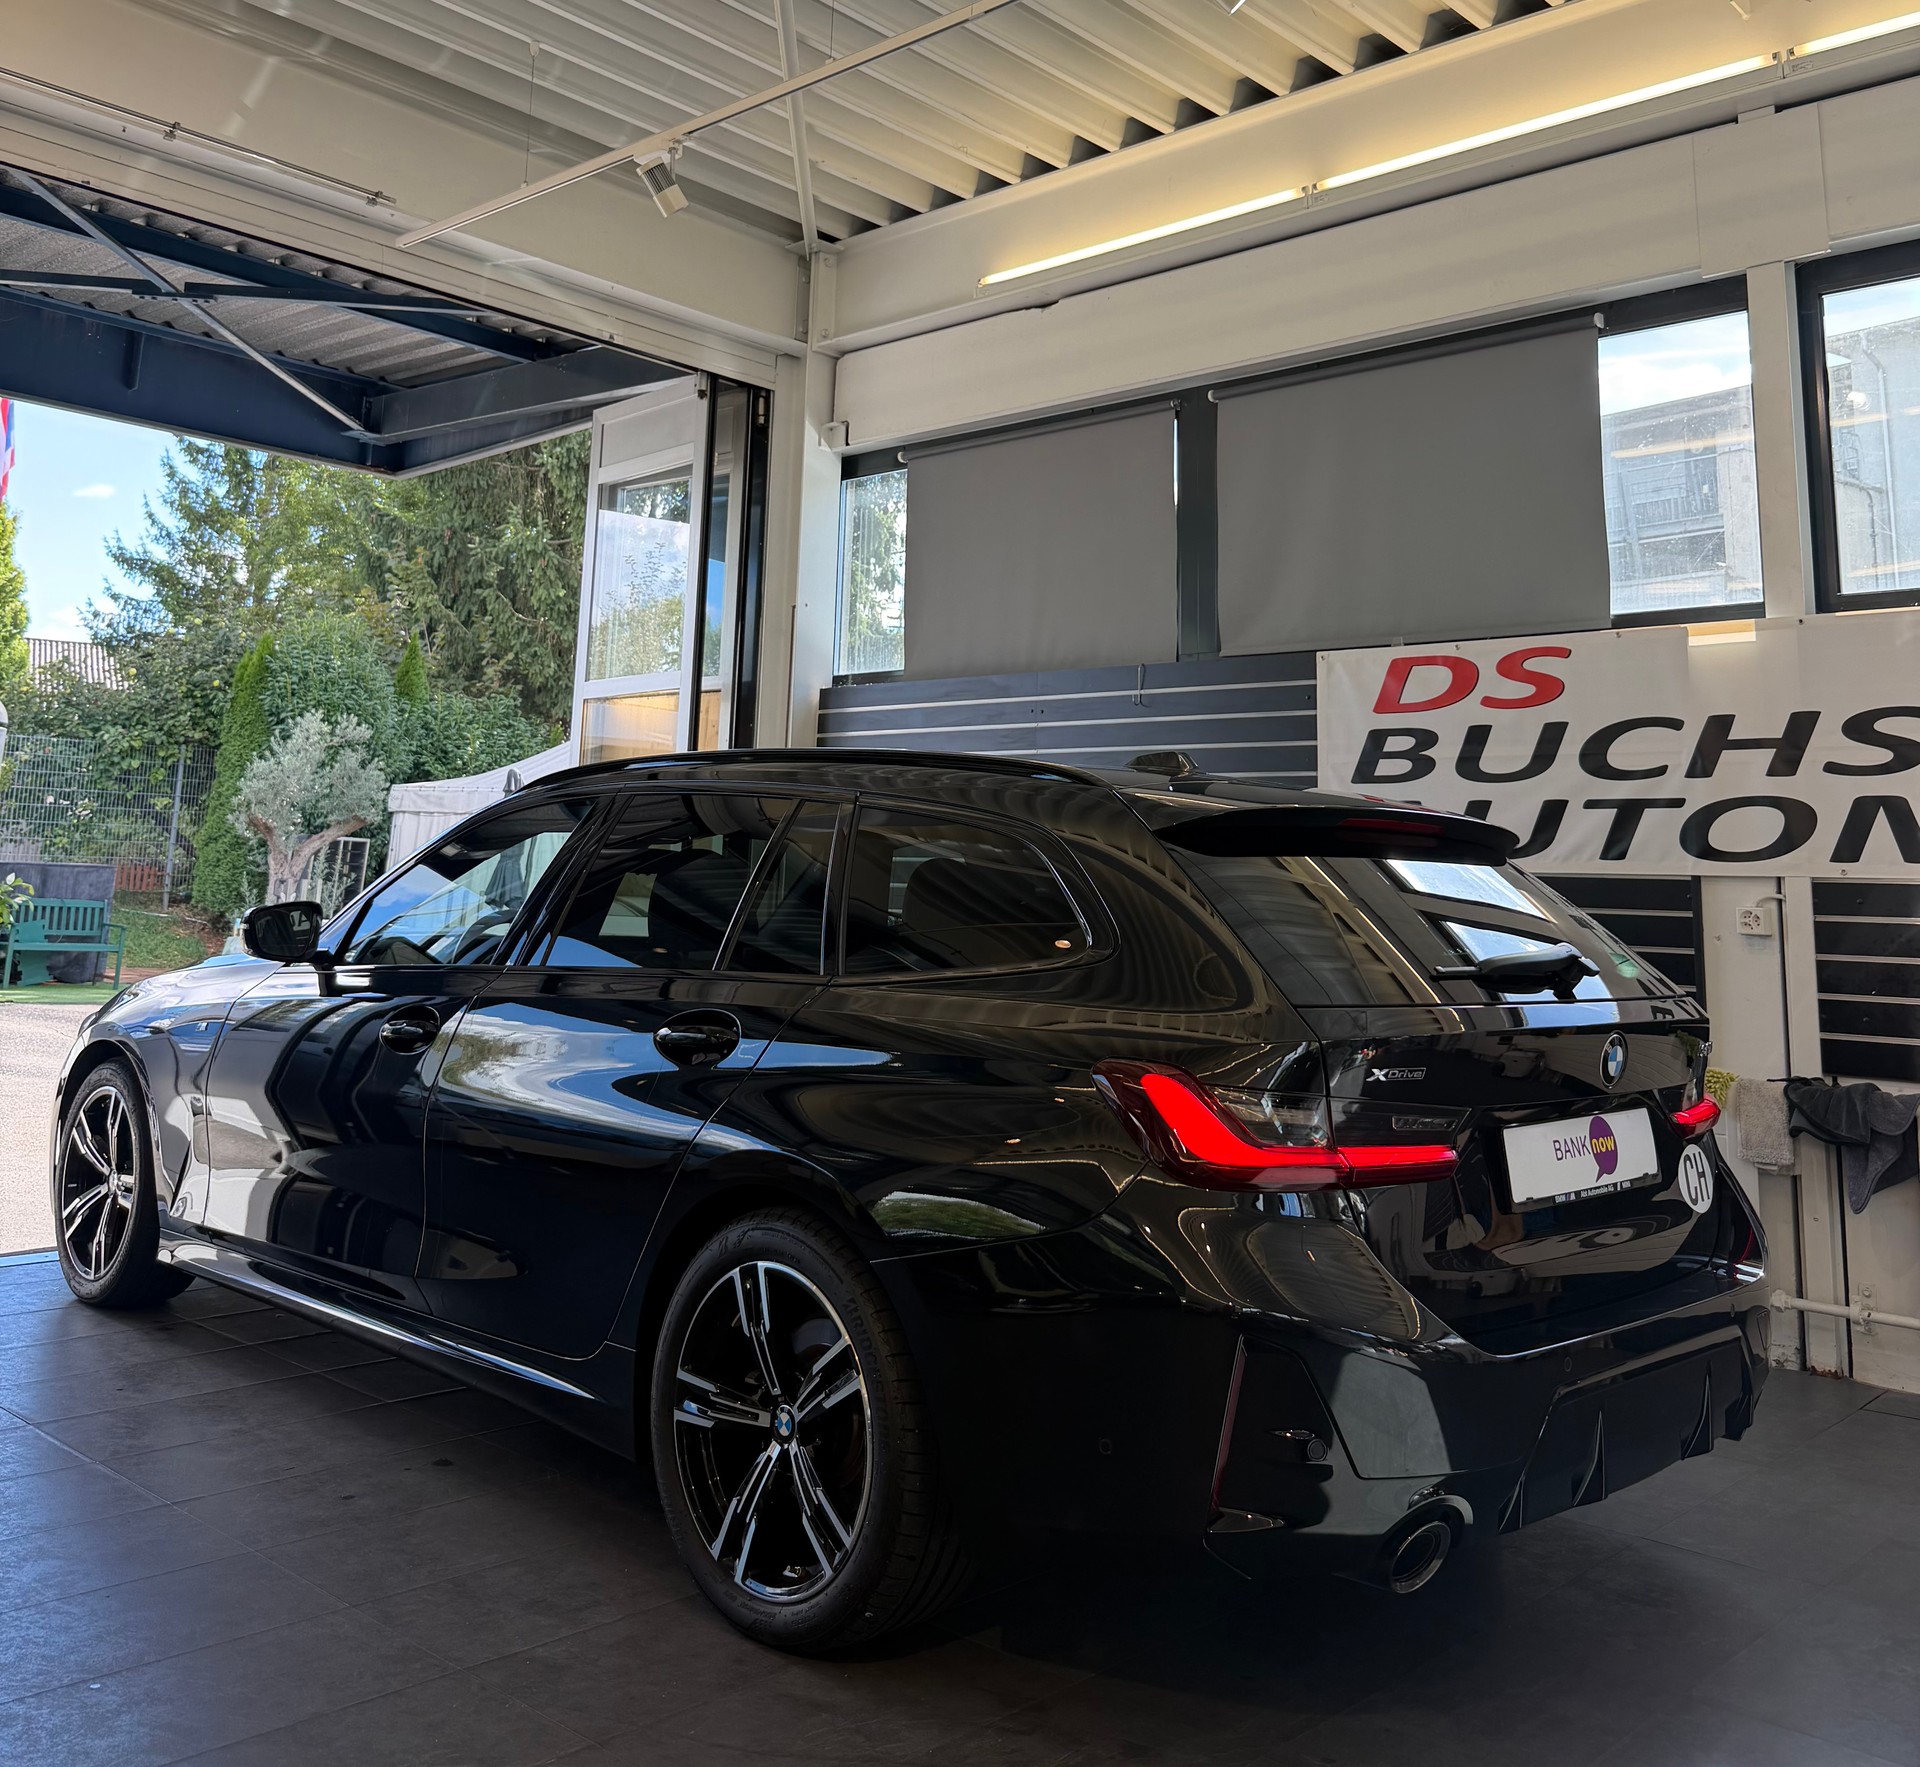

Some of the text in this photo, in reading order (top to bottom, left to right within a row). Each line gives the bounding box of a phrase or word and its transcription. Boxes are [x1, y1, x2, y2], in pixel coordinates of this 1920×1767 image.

[1373, 646, 1571, 714] DS
[1351, 706, 1920, 784] BUCHS
[1403, 795, 1920, 863] UTO
[1553, 1135, 1615, 1161] BANK now
[1684, 1151, 1710, 1206] CH
